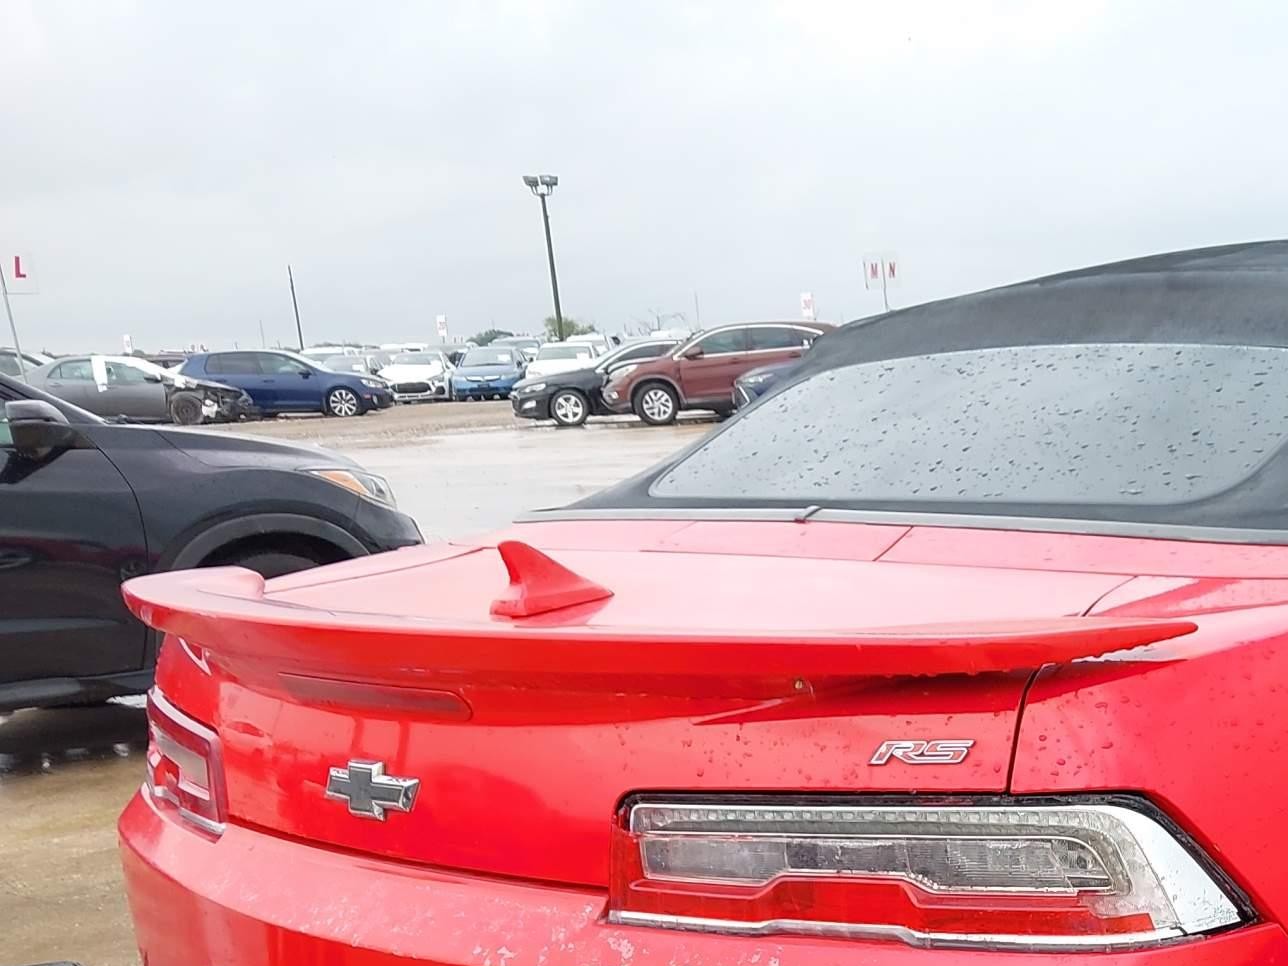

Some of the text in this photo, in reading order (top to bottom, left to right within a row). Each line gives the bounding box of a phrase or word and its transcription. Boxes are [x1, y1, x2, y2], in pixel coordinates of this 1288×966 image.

[14, 255, 27, 279] L
[888, 260, 897, 279] N
[868, 739, 976, 766] RS
